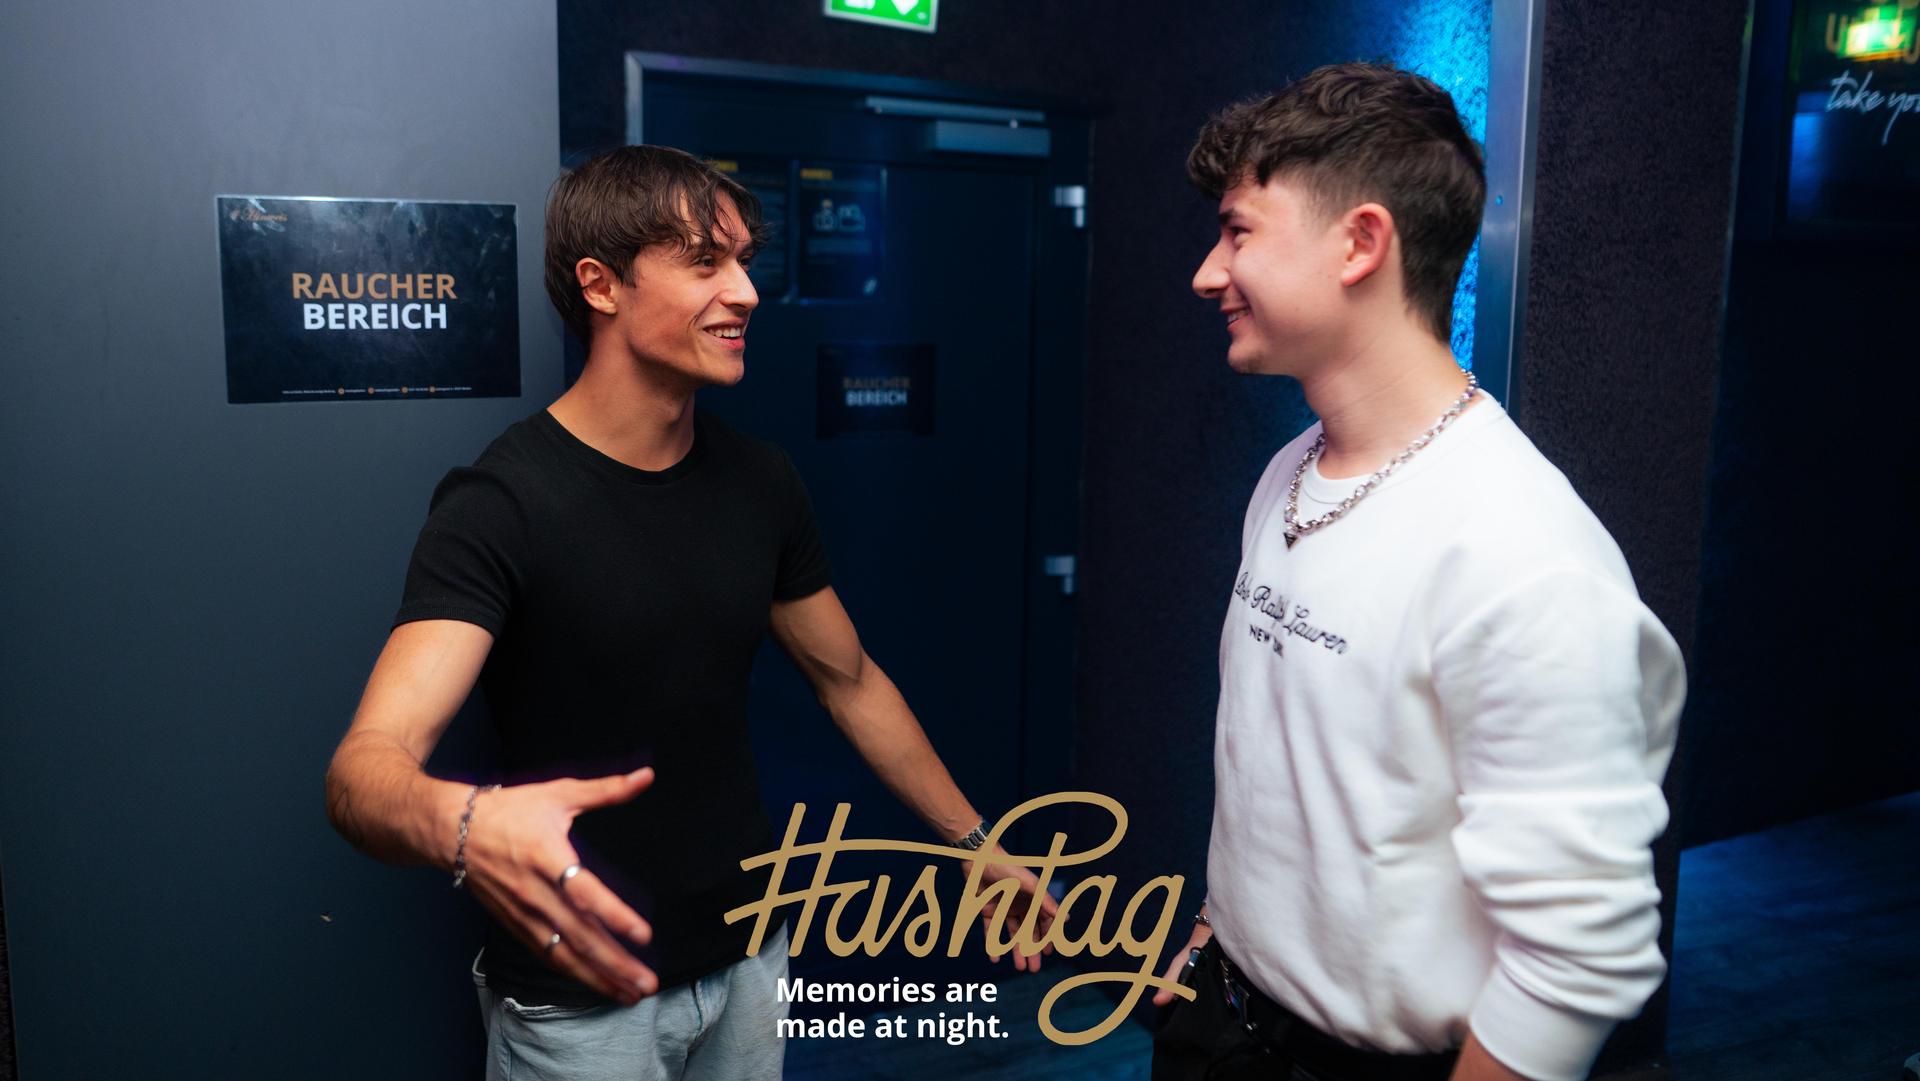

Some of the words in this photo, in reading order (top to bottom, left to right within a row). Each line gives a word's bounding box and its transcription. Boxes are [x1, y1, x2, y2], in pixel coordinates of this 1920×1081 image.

[1825, 69, 1885, 114] take
[1882, 91, 1920, 146] yo
[291, 272, 458, 300] RAUCHER
[303, 303, 448, 330] BEREICH
[843, 376, 911, 389] RAUCHER
[845, 390, 908, 406] BEREICH
[1249, 623, 1271, 642] NEW
[1282, 604, 1348, 655] Lauren
